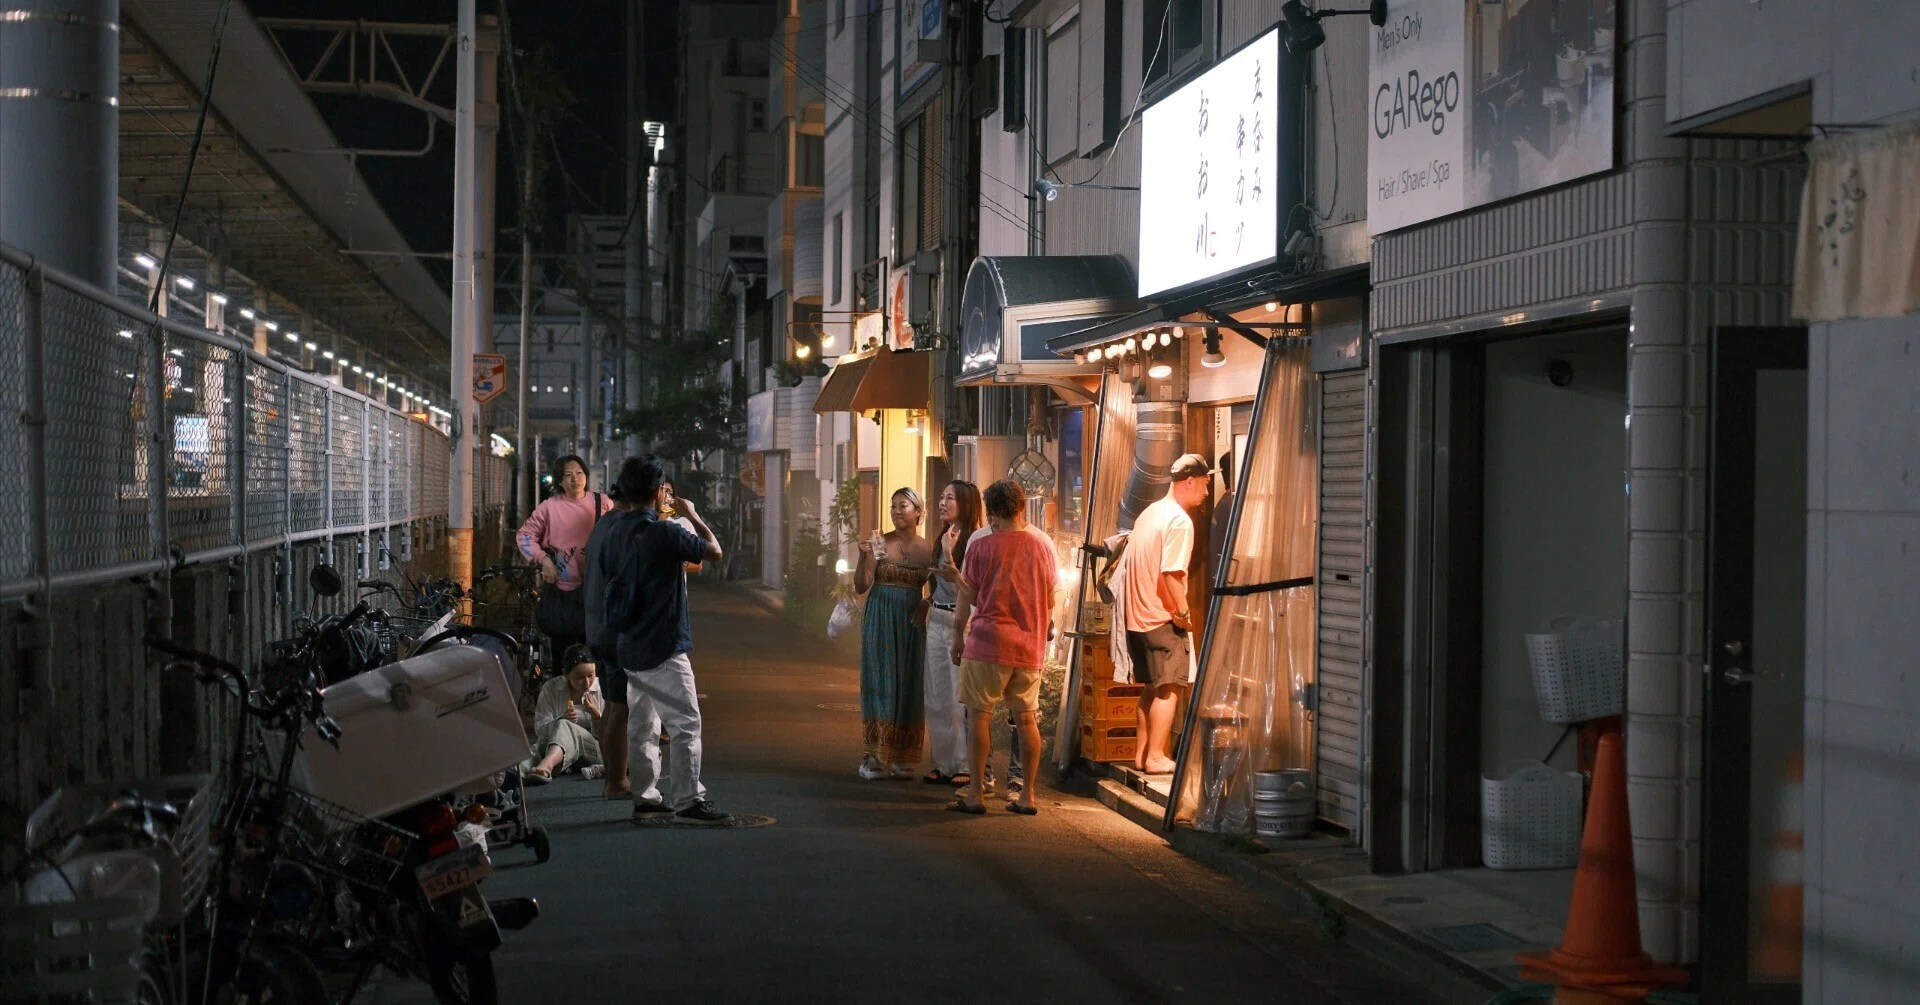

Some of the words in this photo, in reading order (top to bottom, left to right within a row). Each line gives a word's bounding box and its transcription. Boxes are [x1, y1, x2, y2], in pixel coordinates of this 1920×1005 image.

[1377, 22, 1400, 52] Men's
[1402, 11, 1422, 41] Only
[1374, 69, 1459, 139] GARego
[1196, 89, 1209, 260] おお川
[1235, 113, 1246, 256] 串カツ
[1378, 172, 1395, 201] Hair
[1401, 165, 1425, 194] Shave
[1432, 159, 1450, 190] Spa
